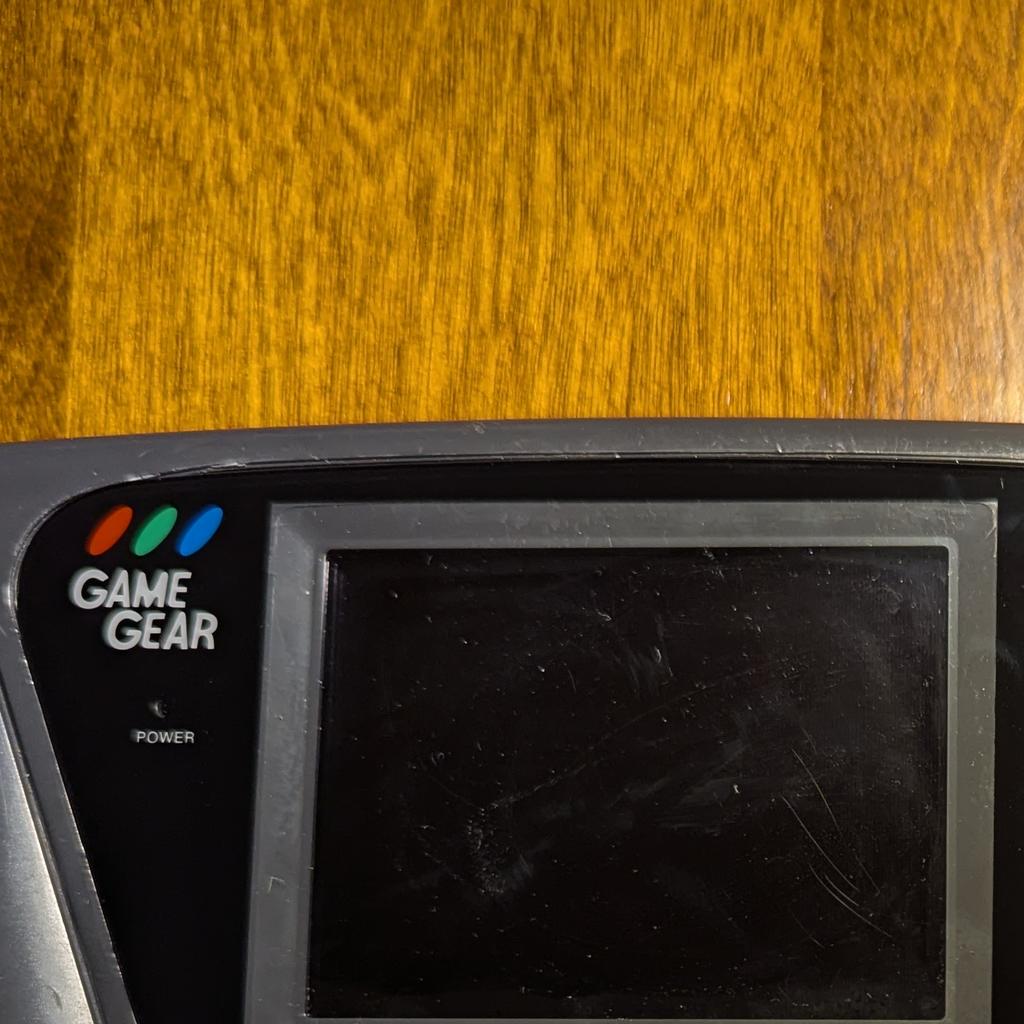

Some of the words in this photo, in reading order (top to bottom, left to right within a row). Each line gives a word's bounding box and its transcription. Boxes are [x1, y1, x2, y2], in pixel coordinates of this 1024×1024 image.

[70, 566, 192, 610] GAME
[104, 609, 219, 650] GEAR
[136, 731, 195, 744] POWER
